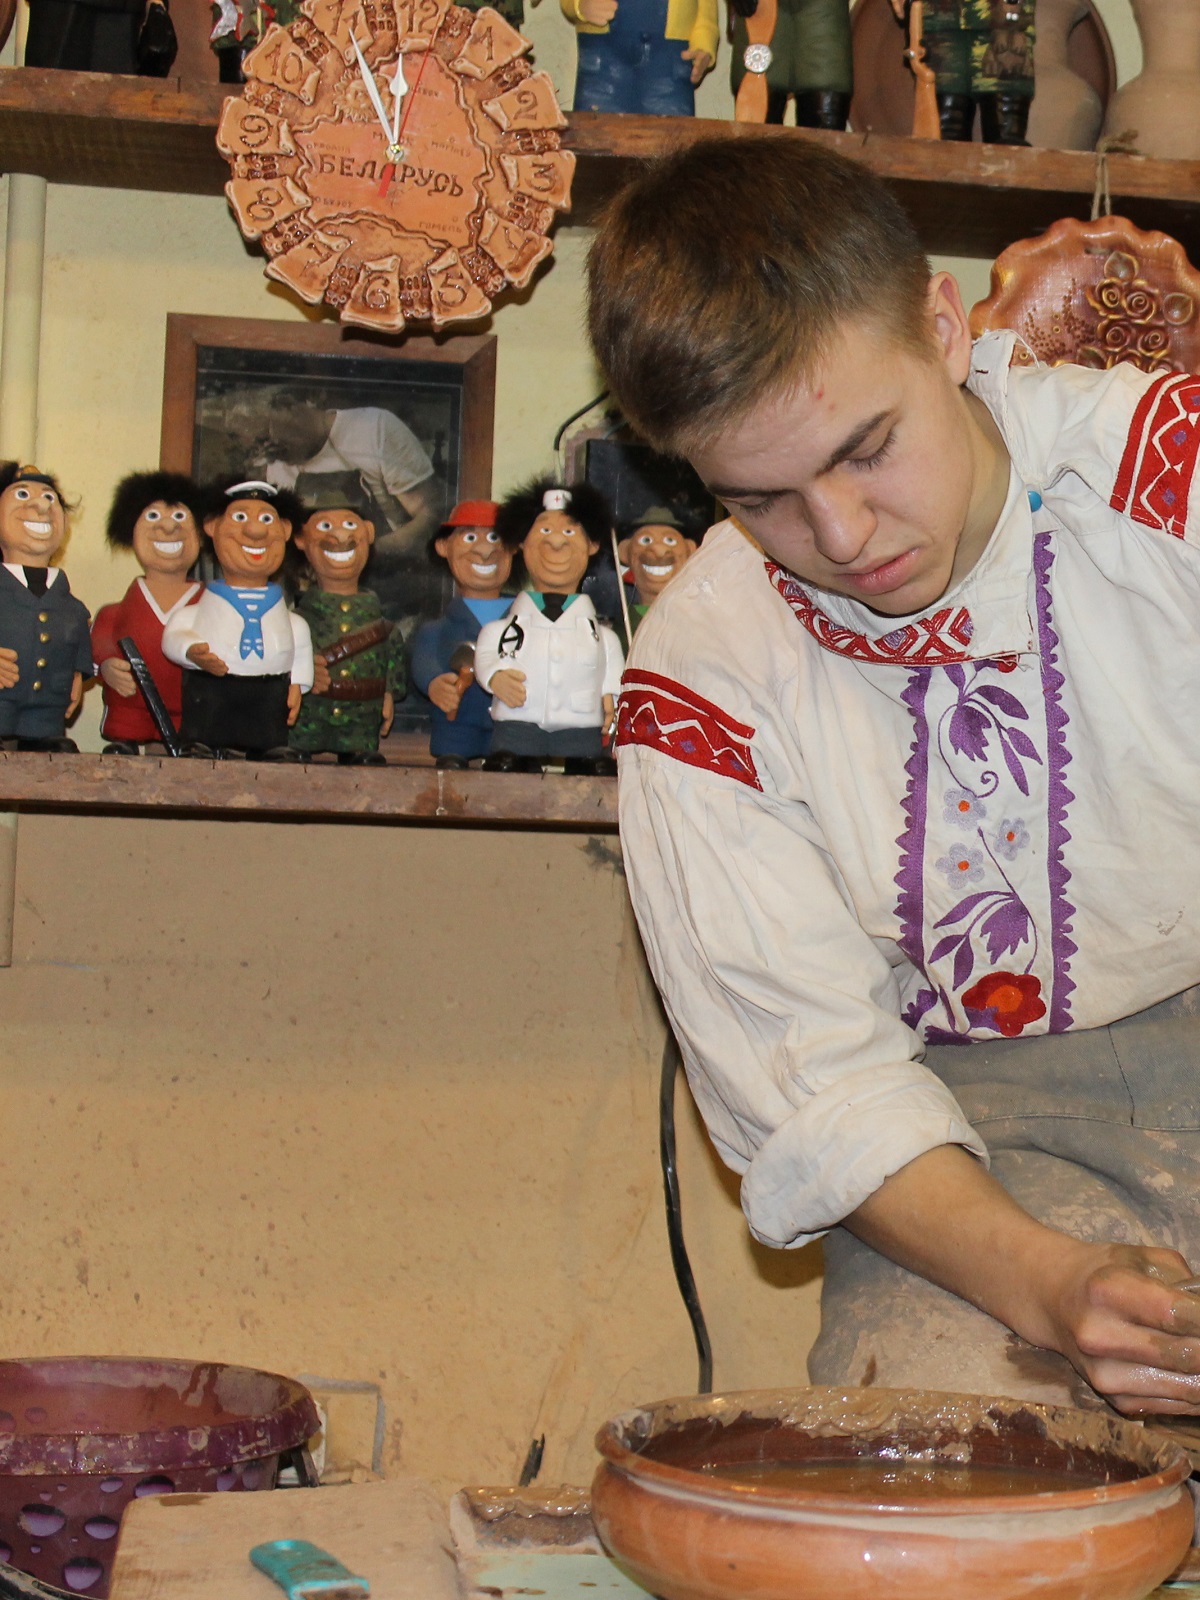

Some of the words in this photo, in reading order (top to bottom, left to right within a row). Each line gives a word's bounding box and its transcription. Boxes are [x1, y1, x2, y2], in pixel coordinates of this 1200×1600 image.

[400, 0, 437, 34] 12
[479, 26, 494, 61] 1
[264, 42, 303, 84] 10
[514, 90, 538, 121] 2
[239, 114, 273, 147] 9
[318, 153, 464, 197] БЕЛАРУСЬ
[525, 162, 557, 192] 3
[246, 186, 283, 221] 8
[361, 274, 391, 309] 6
[438, 271, 468, 307] 5
